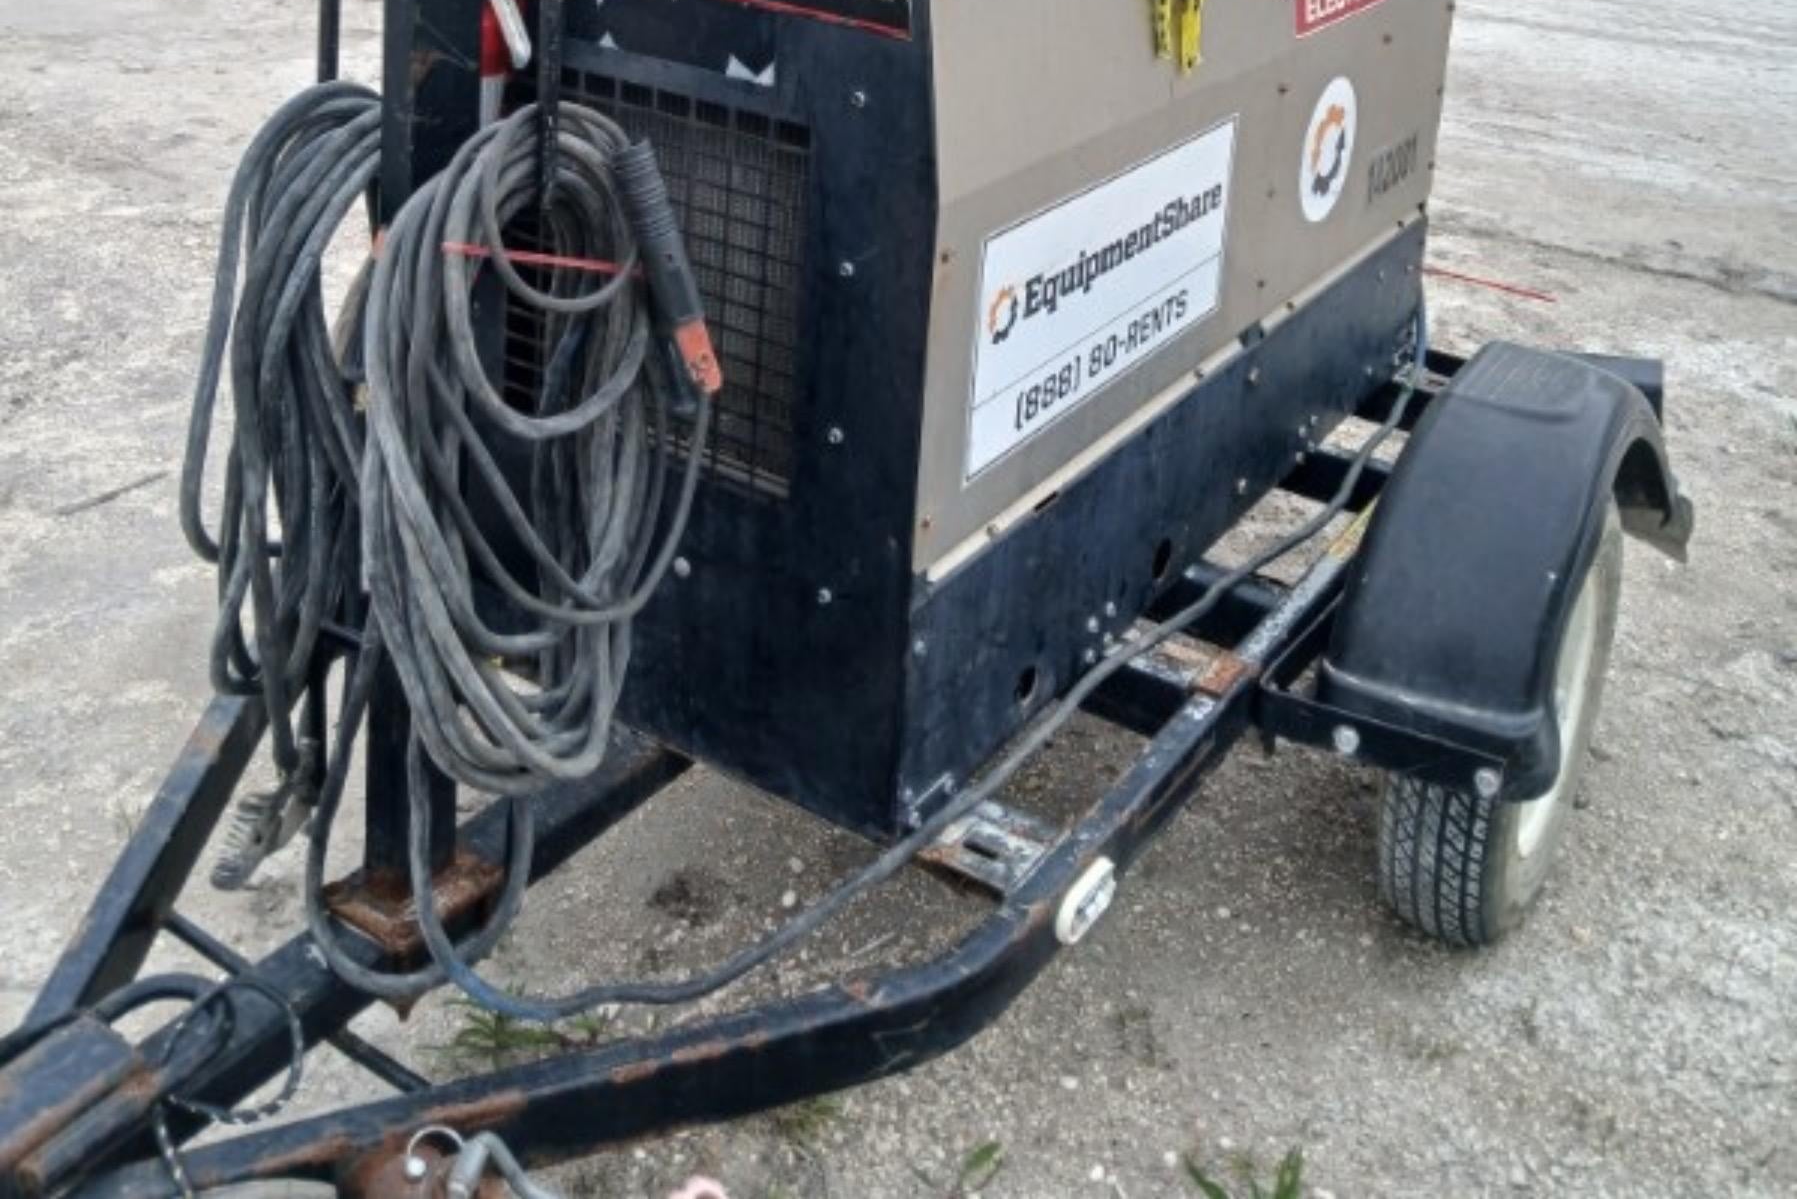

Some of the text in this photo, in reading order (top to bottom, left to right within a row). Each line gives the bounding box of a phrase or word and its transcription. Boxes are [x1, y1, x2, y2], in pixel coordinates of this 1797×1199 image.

[1023, 183, 1223, 317] EquipmentShare
[1014, 289, 1189, 431] (888) 80-RENTS
